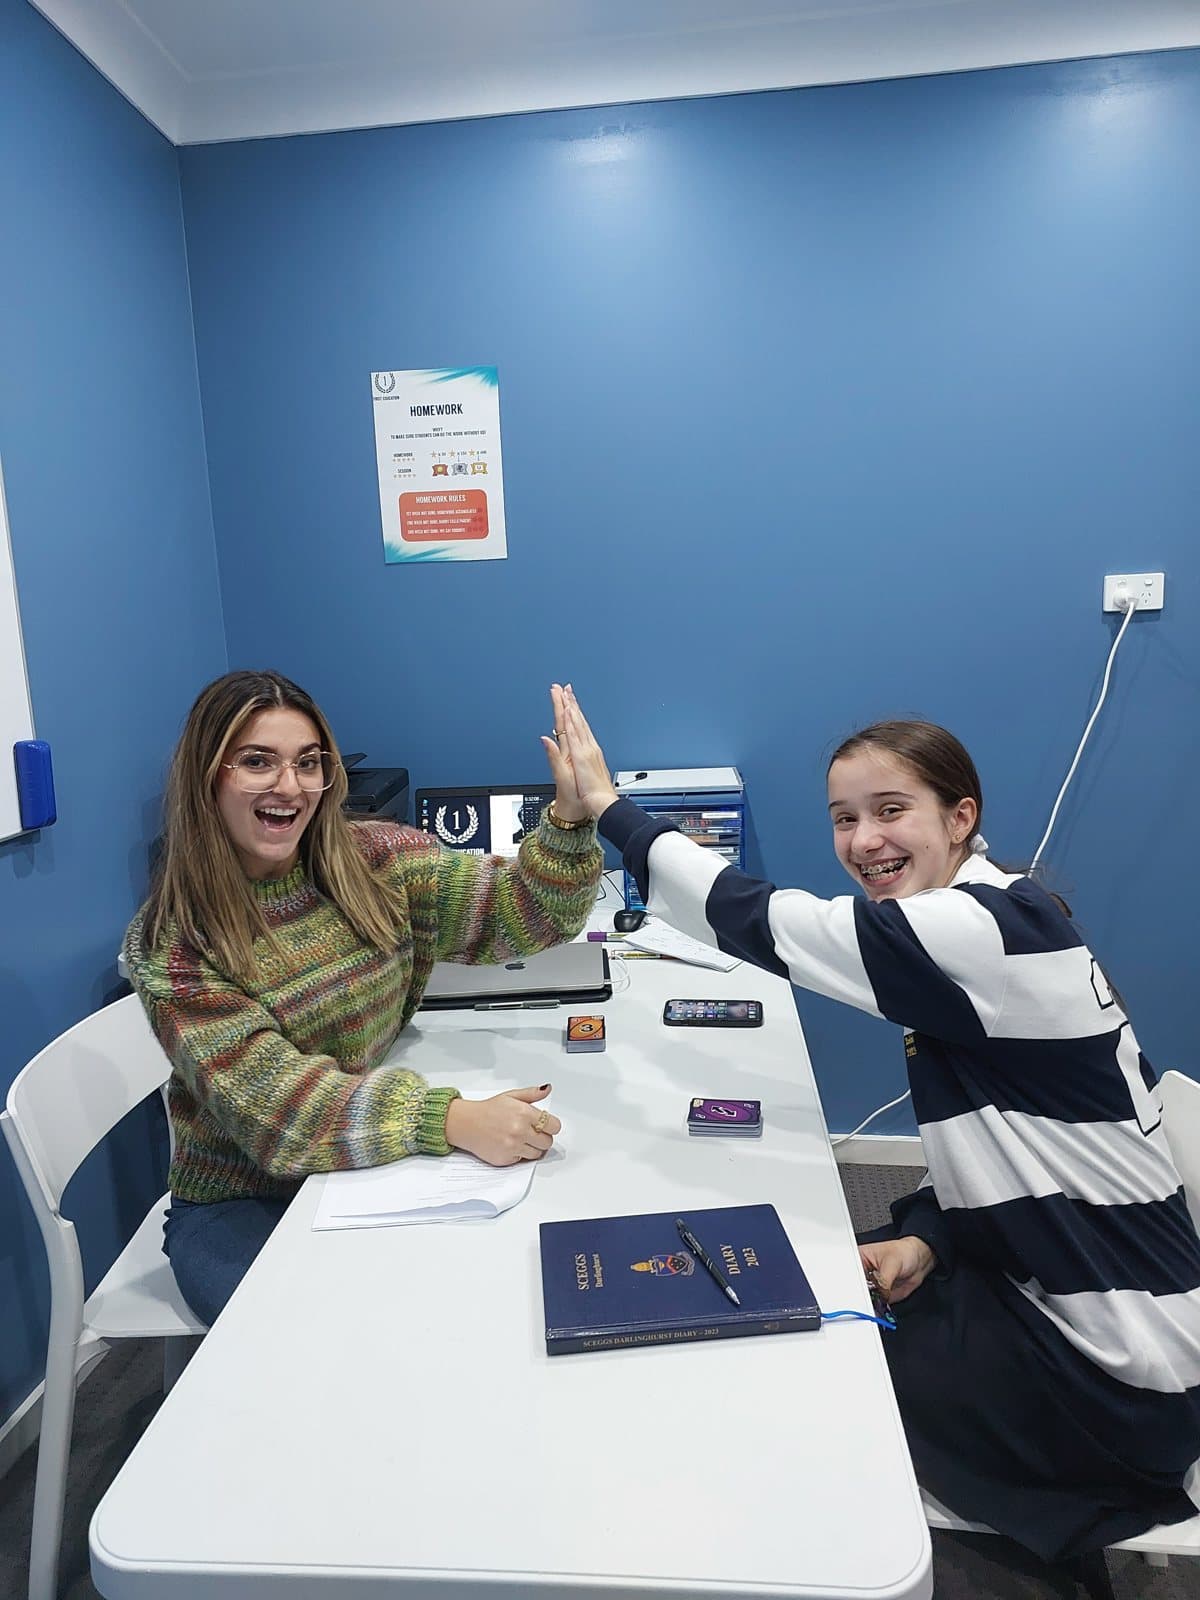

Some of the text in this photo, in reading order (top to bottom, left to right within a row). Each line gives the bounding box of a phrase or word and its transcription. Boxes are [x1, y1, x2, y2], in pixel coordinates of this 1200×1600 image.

[410, 404, 463, 417] HOMEWORK
[415, 494, 466, 504] HOMEWORK RULES
[452, 811, 460, 830] 1
[581, 1024, 594, 1033] 3
[720, 1244, 741, 1275] DIARY
[742, 1247, 760, 1267] 2023
[575, 1253, 589, 1290] SCEGGS
[583, 1338, 614, 1348] SCEGGS
[614, 1332, 672, 1345] DARLINGHURST
[674, 1329, 697, 1339] DIARY
[704, 1327, 719, 1336] 2023
